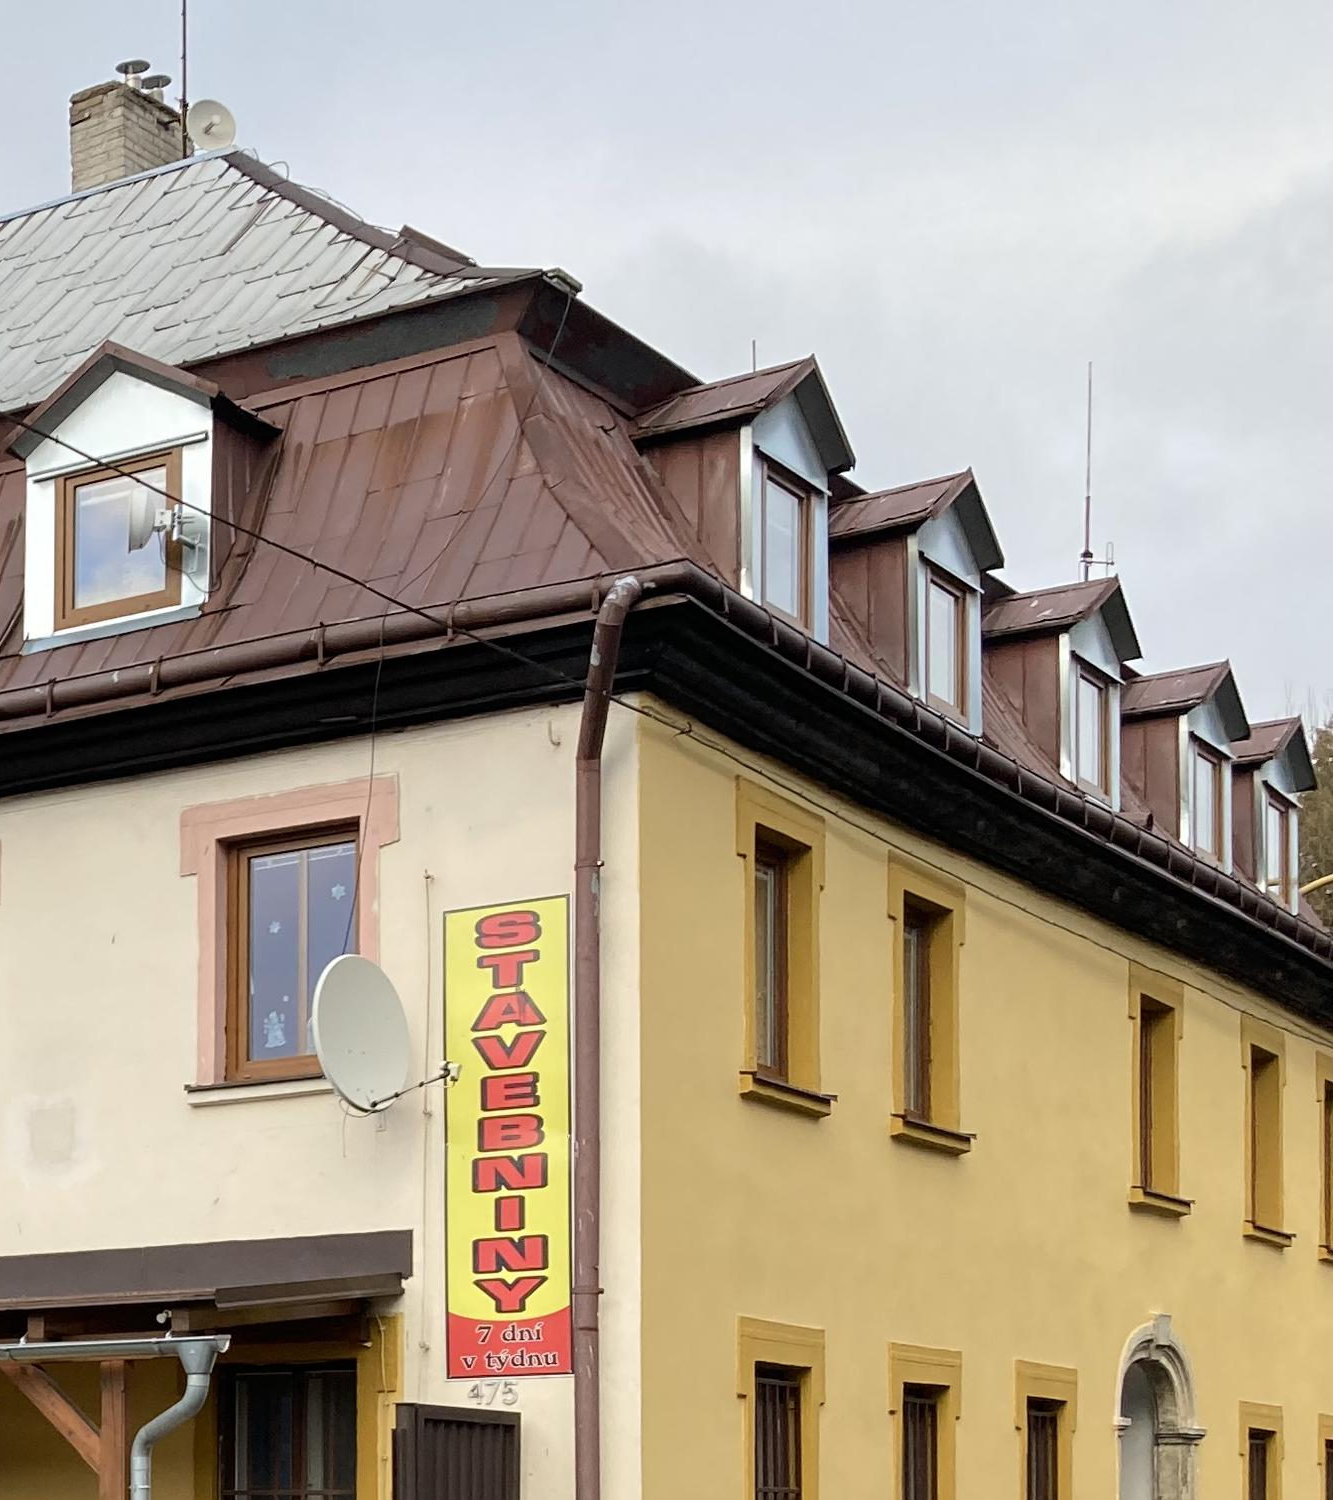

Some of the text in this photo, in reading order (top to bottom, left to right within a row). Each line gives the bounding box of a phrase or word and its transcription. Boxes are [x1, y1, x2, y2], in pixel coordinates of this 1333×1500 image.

[471, 910, 548, 1314] STAVEBNINY
[475, 1322, 544, 1344] 7 dní
[461, 1347, 559, 1372] v týdnu
[468, 1381, 519, 1406] 475
